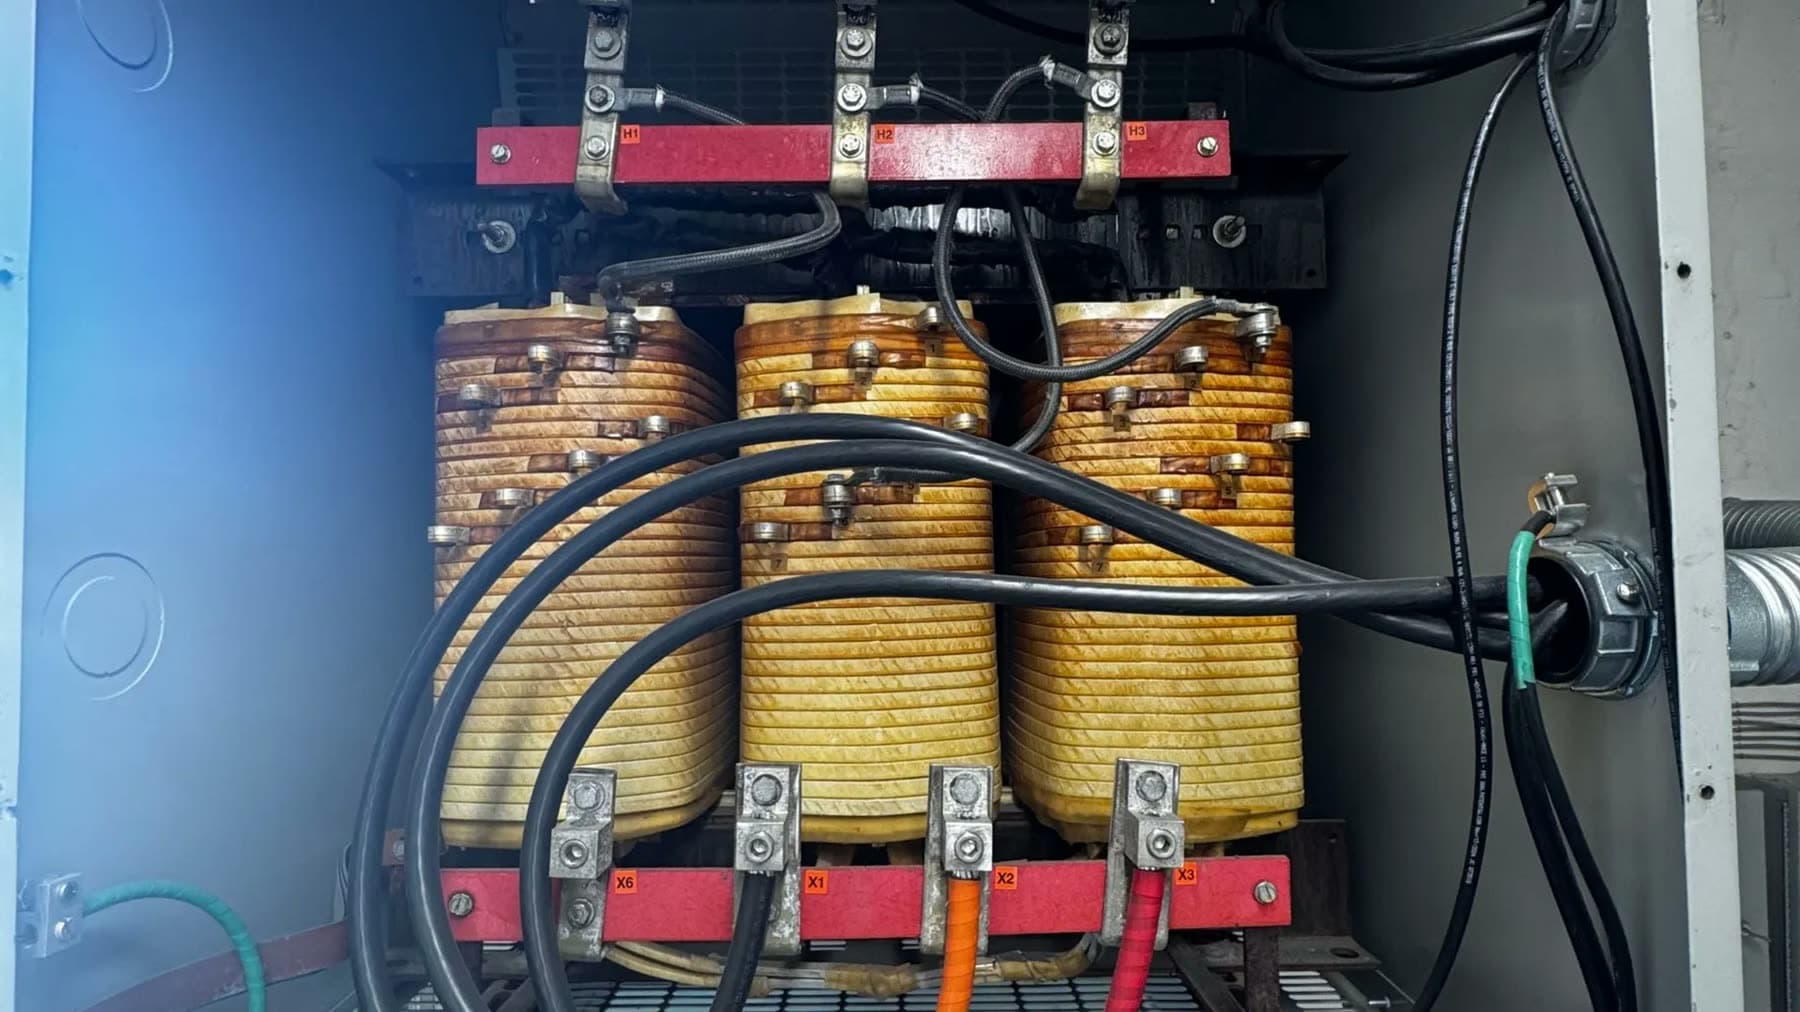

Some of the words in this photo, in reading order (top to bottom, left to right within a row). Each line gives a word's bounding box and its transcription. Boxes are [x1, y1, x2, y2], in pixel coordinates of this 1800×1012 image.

[624, 129, 639, 138] H1
[877, 129, 893, 139] H2
[1129, 126, 1145, 136] H3
[775, 559, 782, 568] 7
[1096, 562, 1103, 571] 7
[996, 873, 1014, 885] X2
[1178, 869, 1194, 881] X3
[617, 876, 634, 888] X6
[808, 876, 824, 888] X1
